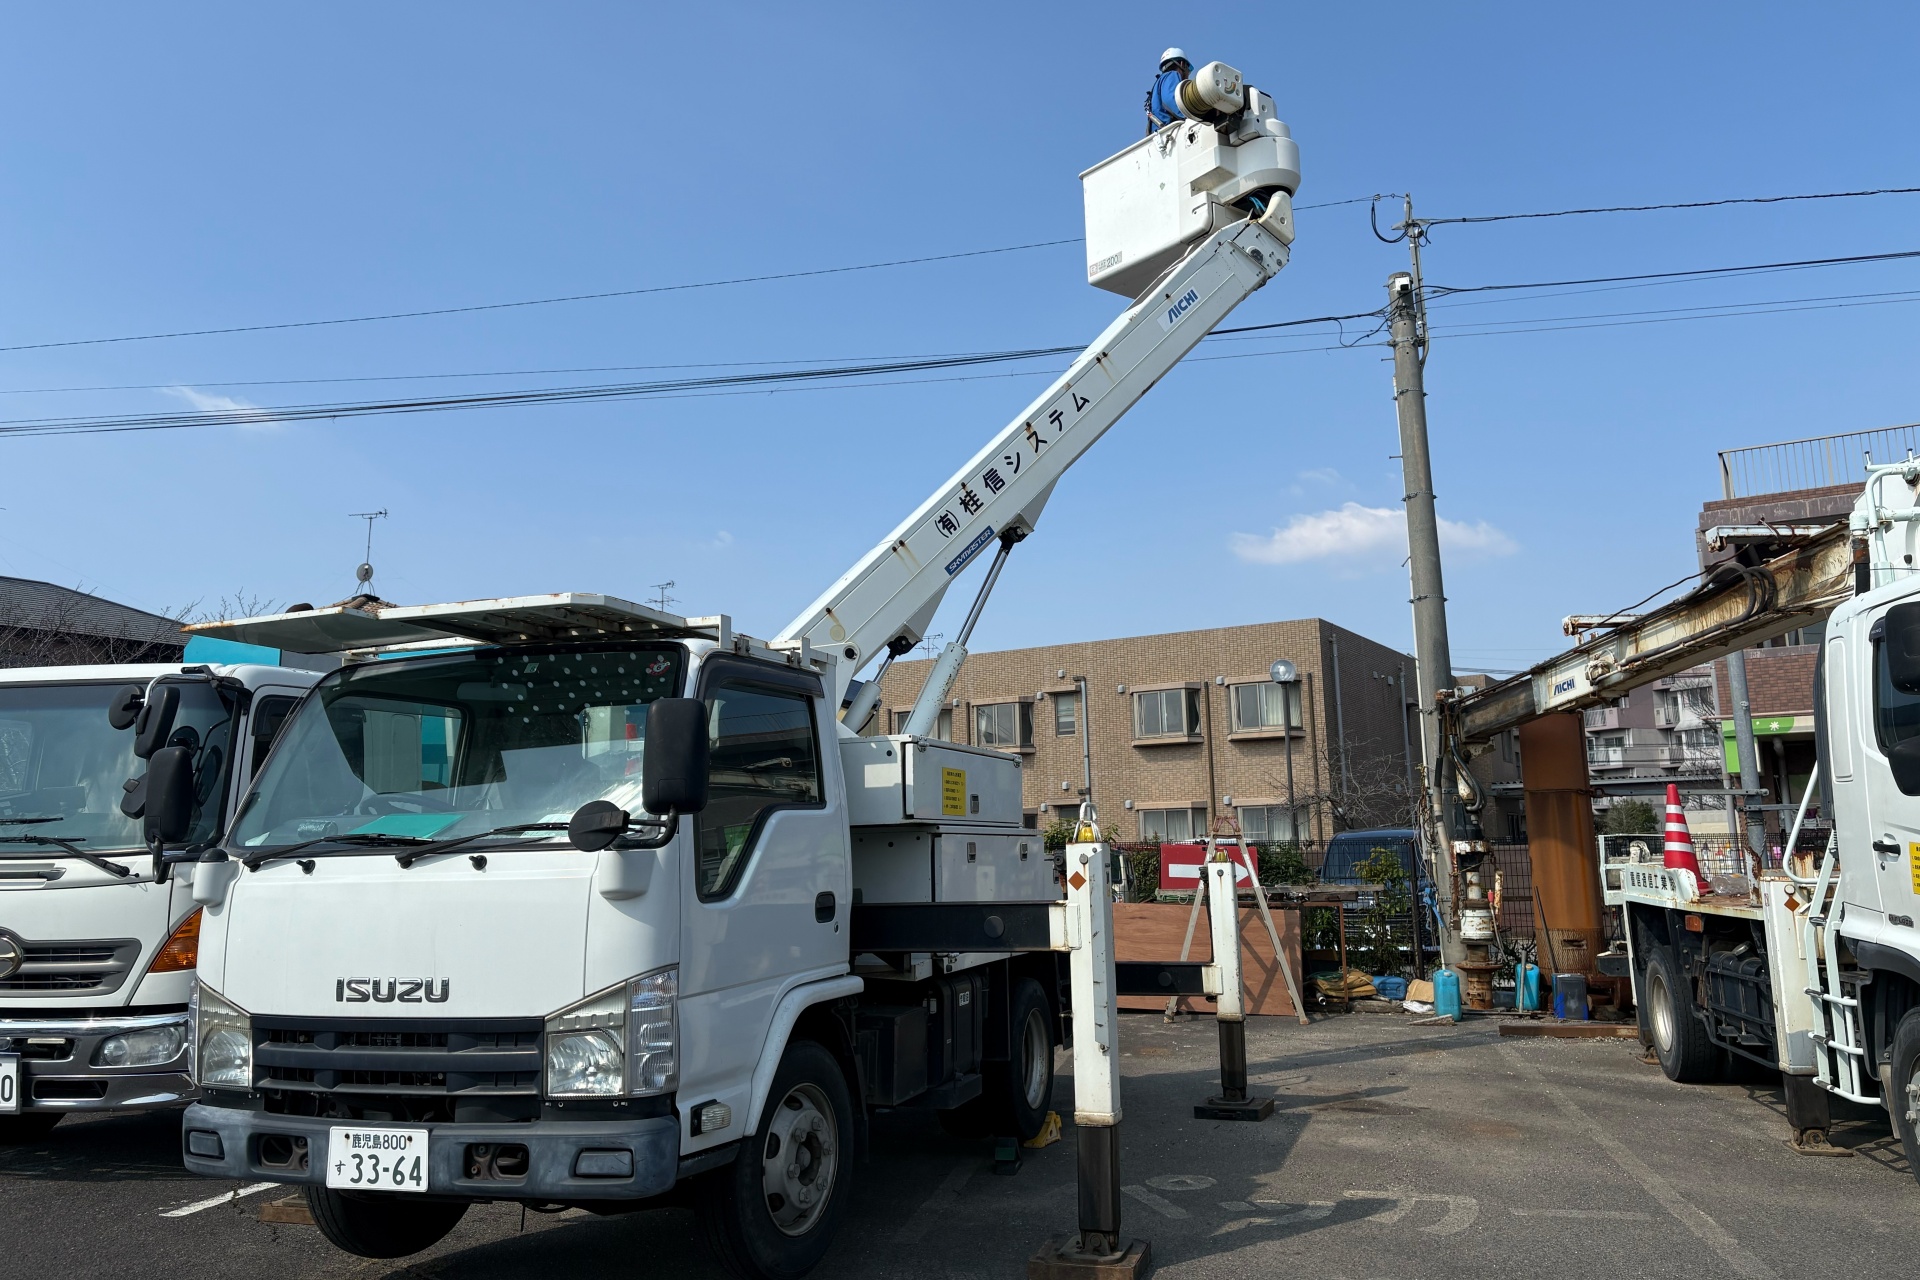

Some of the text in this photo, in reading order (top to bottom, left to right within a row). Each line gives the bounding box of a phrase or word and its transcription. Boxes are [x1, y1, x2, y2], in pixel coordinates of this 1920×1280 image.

[1167, 289, 1199, 324] AICHI
[948, 529, 992, 573] SKYMASTER
[1553, 678, 1576, 696] AICHI
[335, 976, 450, 1003] ISUZU
[334, 1159, 347, 1176] す
[349, 1152, 423, 1187] 33-64
